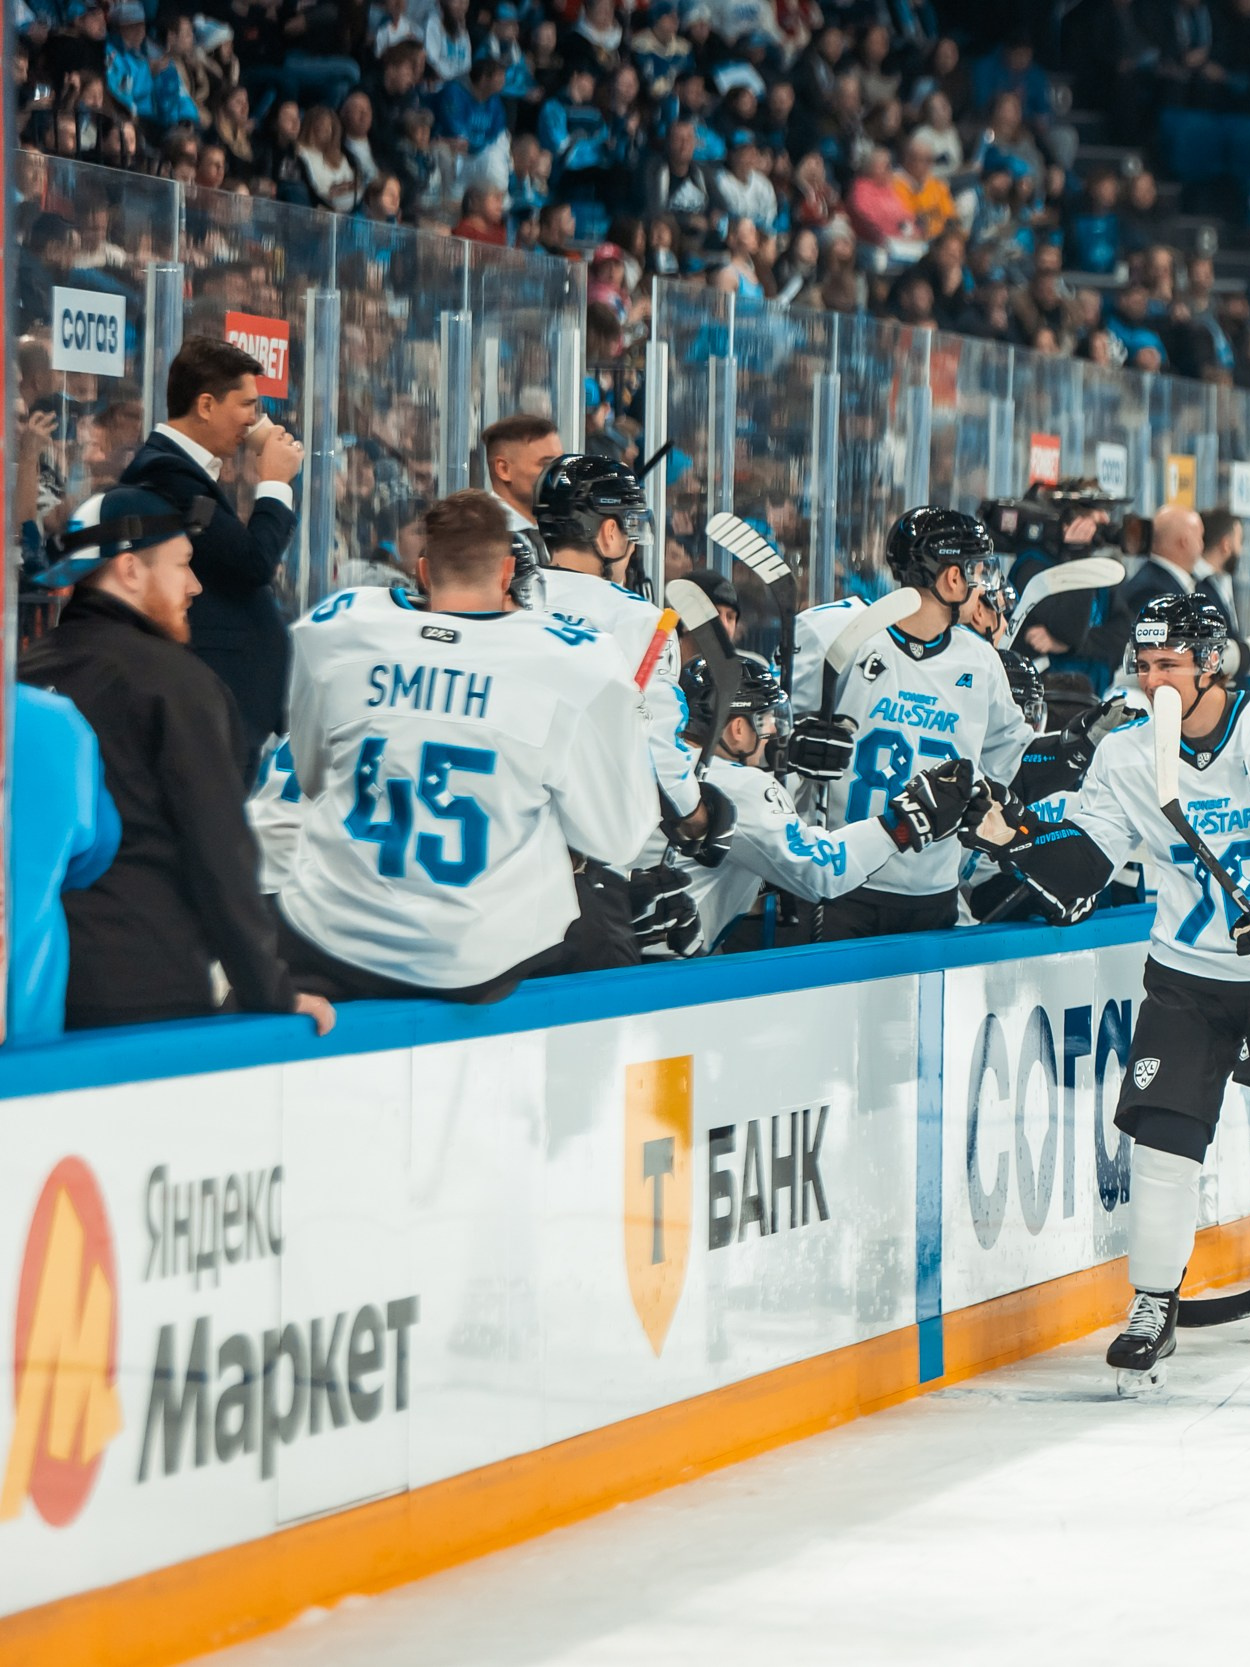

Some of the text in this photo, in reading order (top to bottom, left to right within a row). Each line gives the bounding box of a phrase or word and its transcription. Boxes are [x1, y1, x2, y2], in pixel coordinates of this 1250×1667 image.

[366, 663, 493, 719] SMITH
[343, 737, 498, 888] 45
[1187, 797, 1231, 811] FONBET
[707, 1105, 831, 1252] БАНК
[966, 998, 1132, 1251] сога
[142, 1164, 285, 1290] Яндекс
[136, 1294, 420, 1484] Маркет
